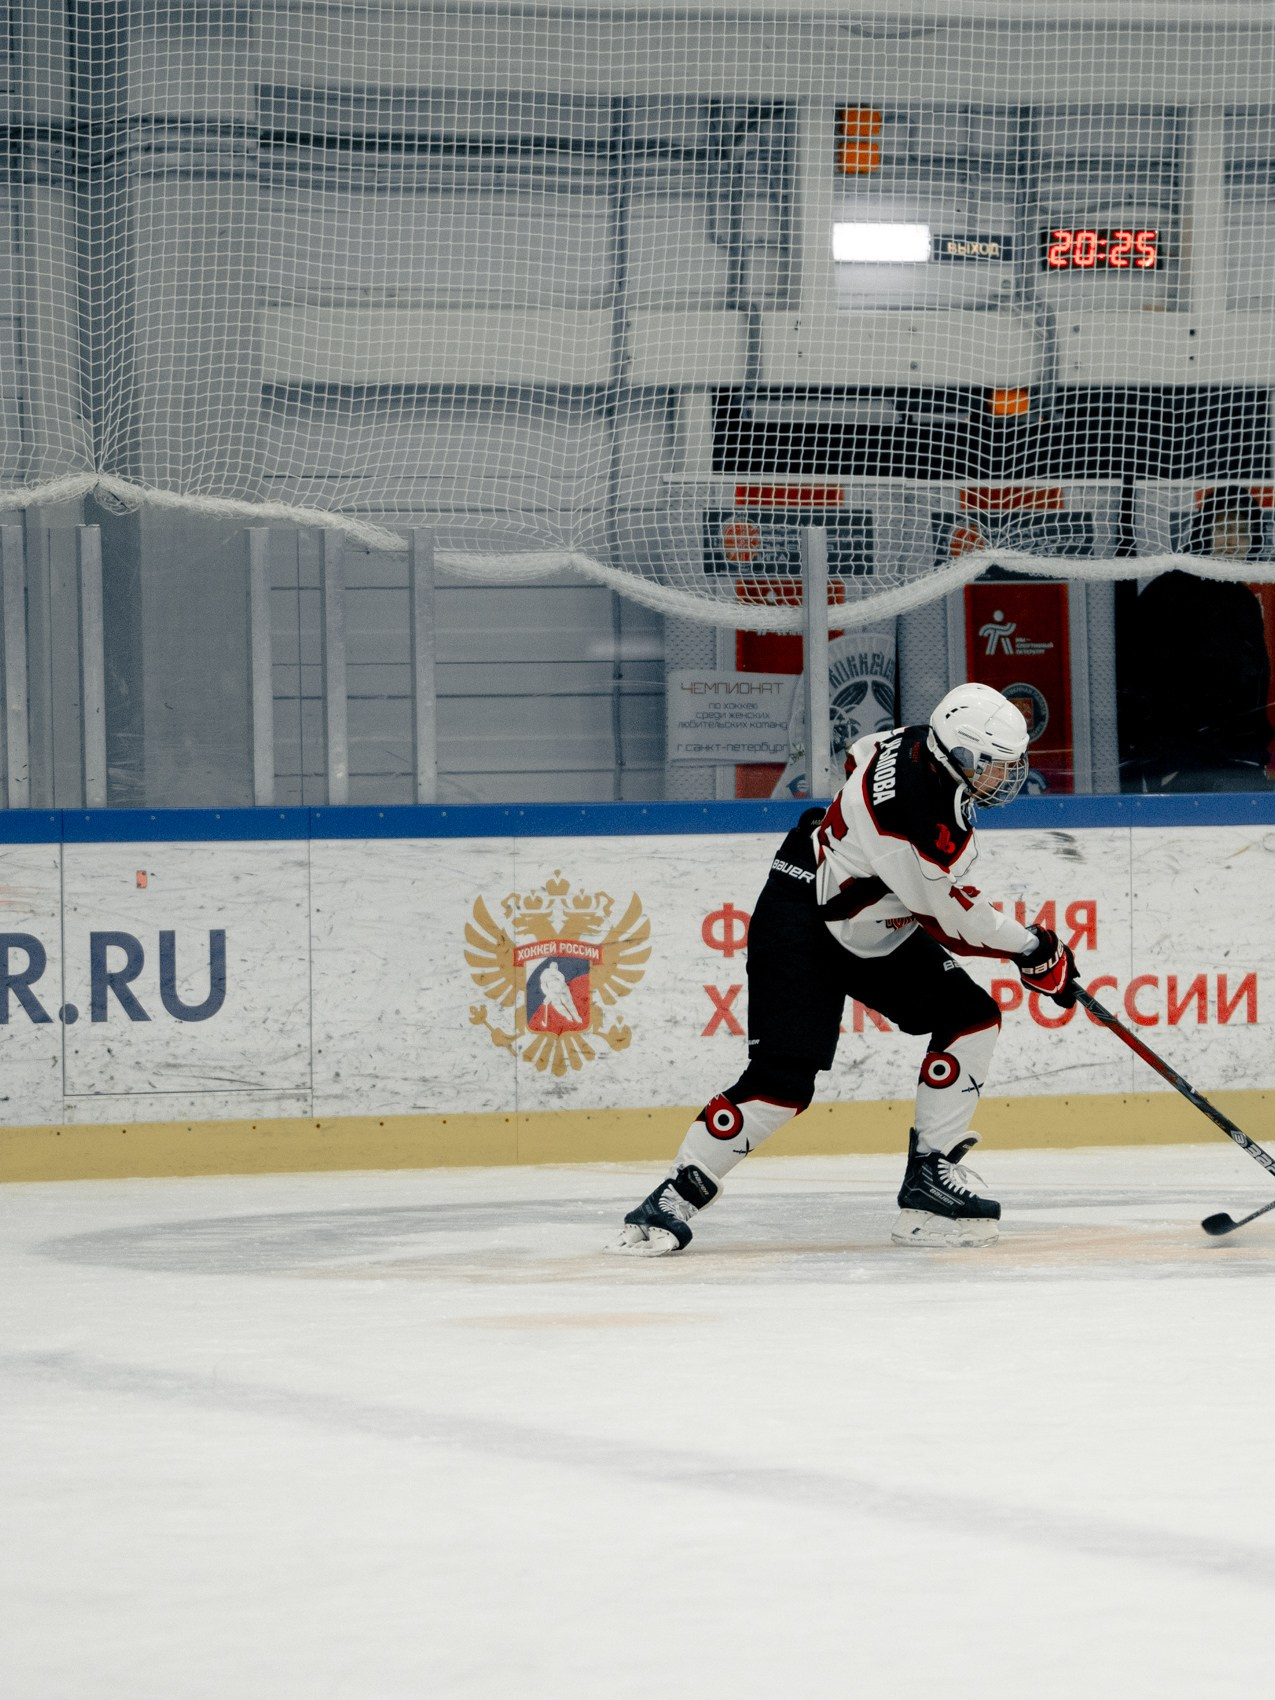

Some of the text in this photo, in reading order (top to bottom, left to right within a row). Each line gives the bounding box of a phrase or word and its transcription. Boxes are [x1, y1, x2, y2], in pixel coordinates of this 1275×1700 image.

[947, 241, 1000, 256] ВЫХОД
[1049, 230, 1157, 268] 20:25
[681, 682, 784, 695] ЧЕМПИОНАТ
[772, 858, 816, 884] BAUER
[517, 941, 600, 960] ХОККЕЙ РОССИИ
[991, 972, 1258, 1029] РОССИИ
